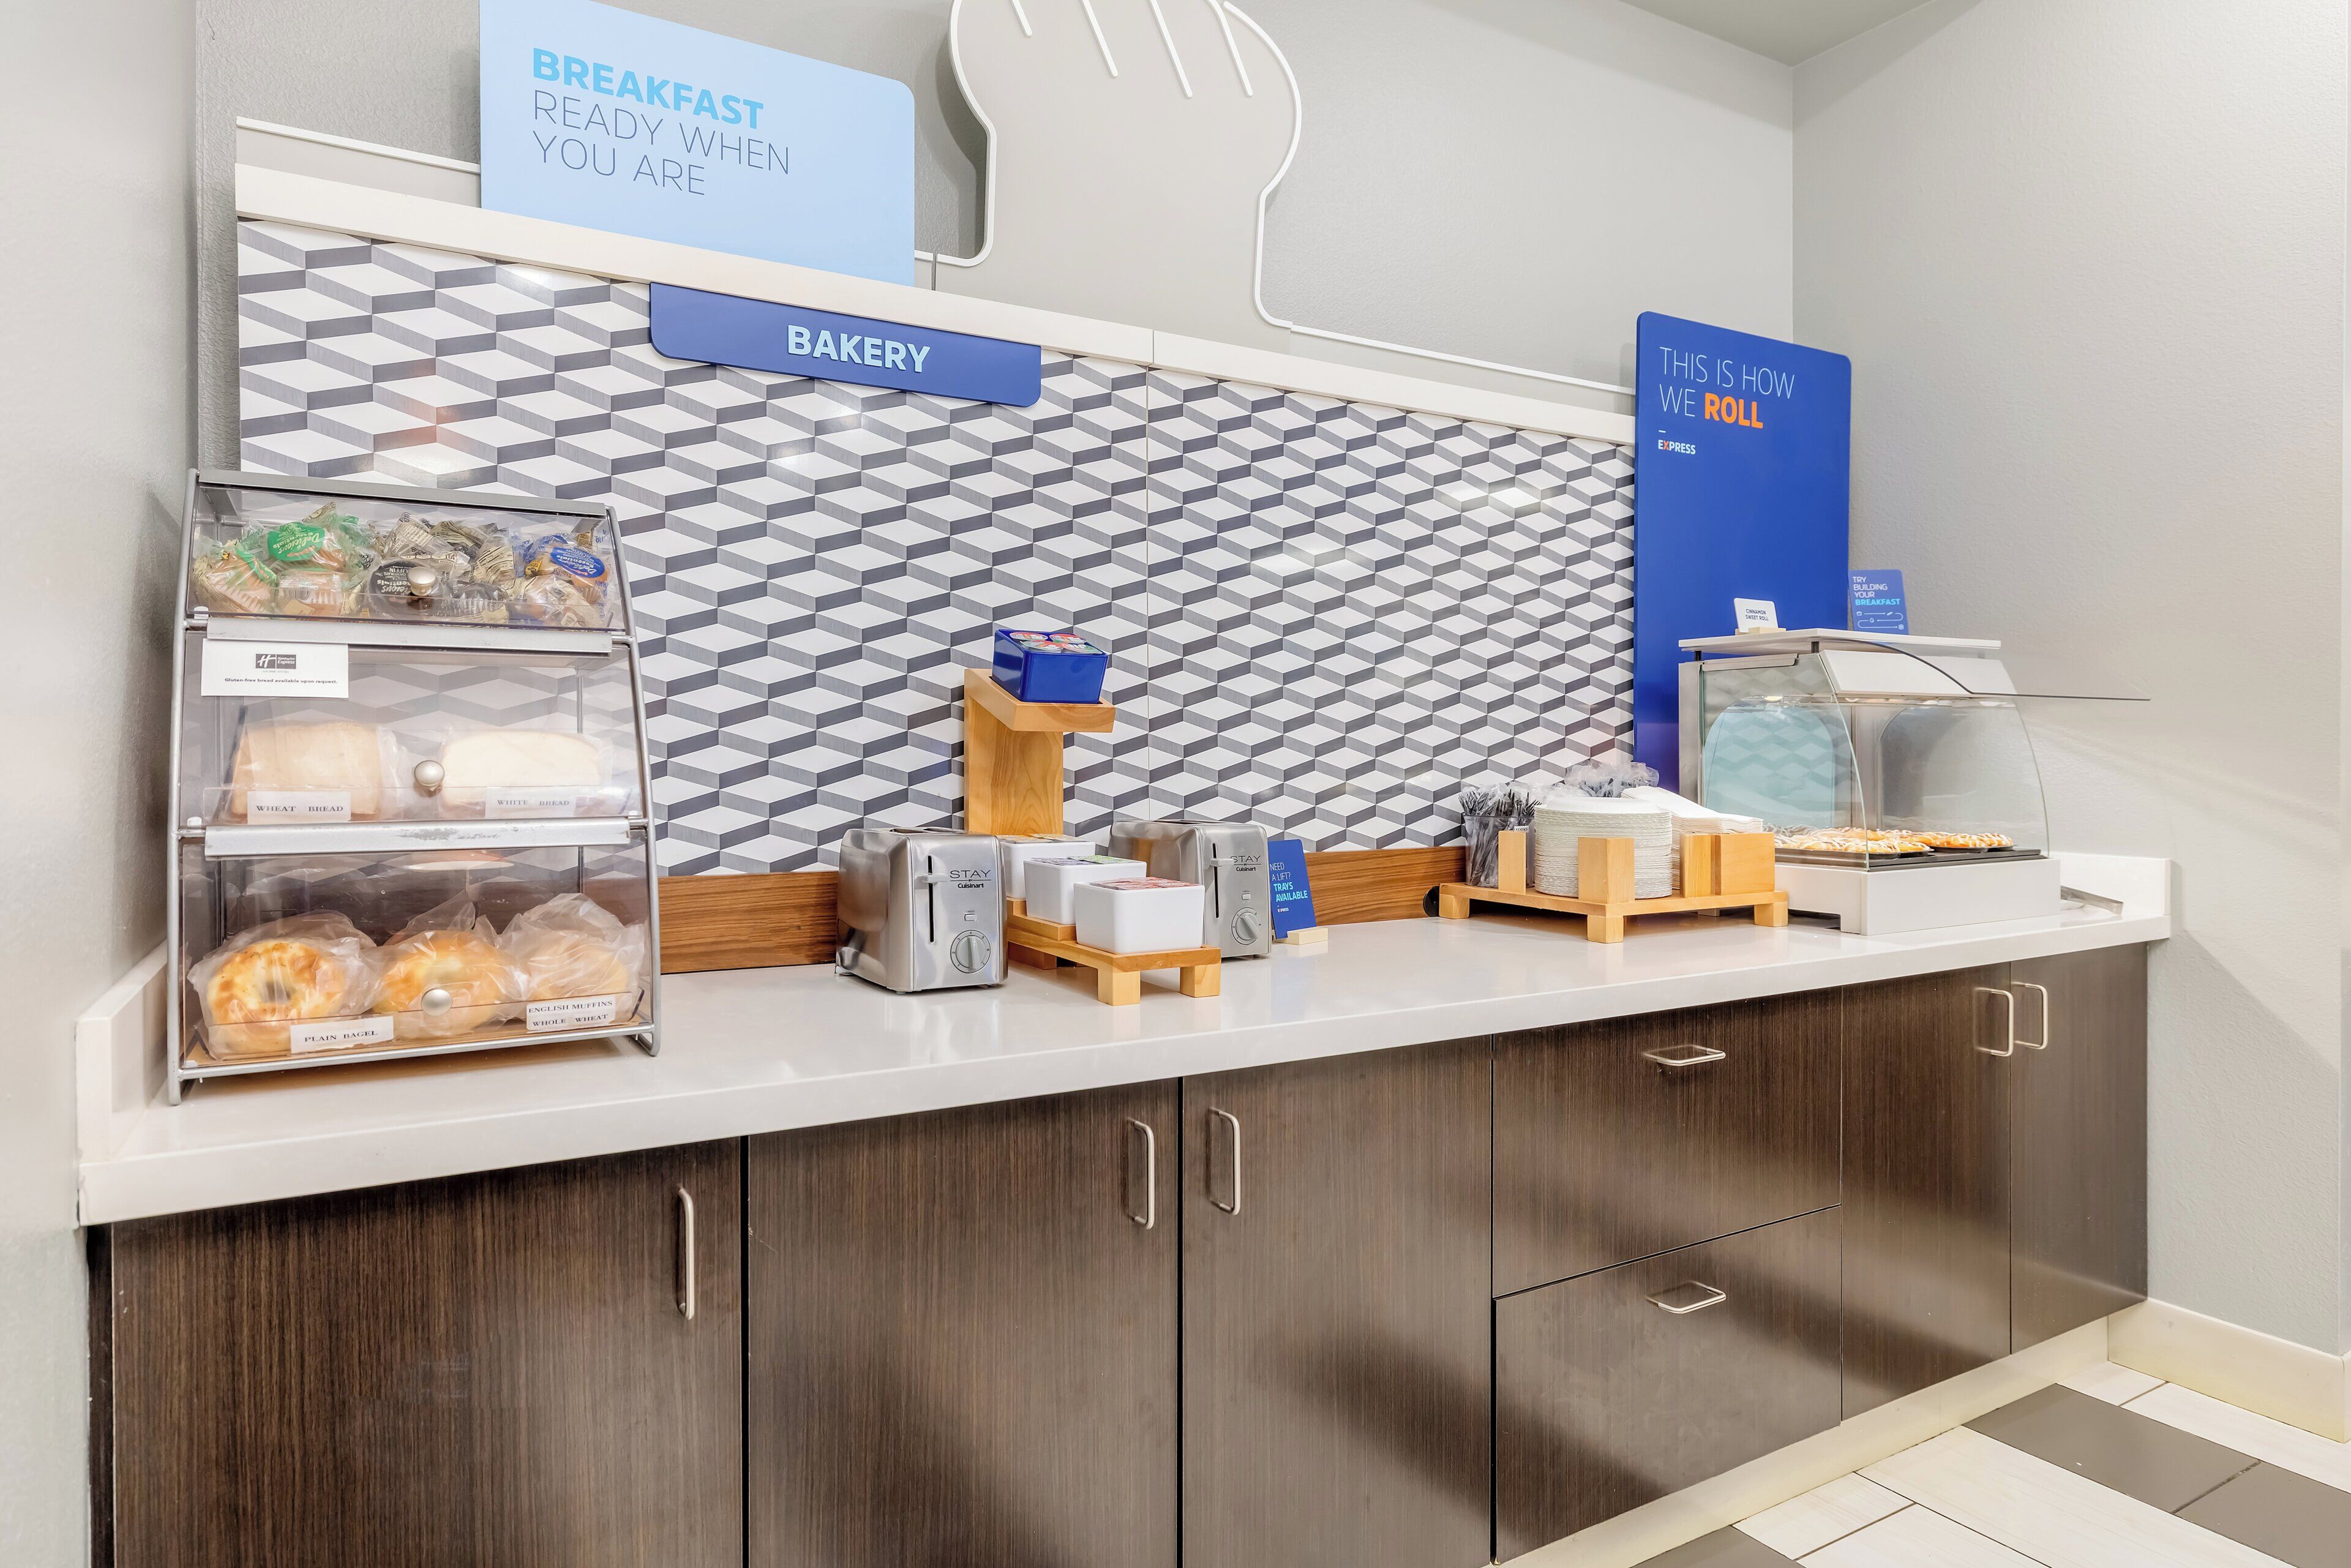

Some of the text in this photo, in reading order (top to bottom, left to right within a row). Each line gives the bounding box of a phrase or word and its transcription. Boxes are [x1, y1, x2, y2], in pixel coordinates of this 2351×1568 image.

[533, 47, 764, 130] BREAKFAST
[534, 89, 789, 174] READY WHEN
[533, 130, 705, 196] YOU ARE
[787, 324, 931, 373] BAKERY
[1659, 346, 1795, 399] THIS IS HOW
[1659, 383, 1764, 429] WE ROLL
[1658, 439, 1696, 455] EXPRESS
[278, 532, 320, 554] Delicious
[381, 585, 411, 596] icious
[950, 869, 991, 879] STAY
[1277, 872, 1291, 881] LIFT?
[1273, 882, 1294, 892] TRAYS
[1276, 890, 1308, 902] AVAILABLE
[528, 1000, 613, 1013] ENGLISH MUFFINS
[575, 1014, 609, 1023] WHEAT
[343, 1030, 378, 1039] BAGEL
